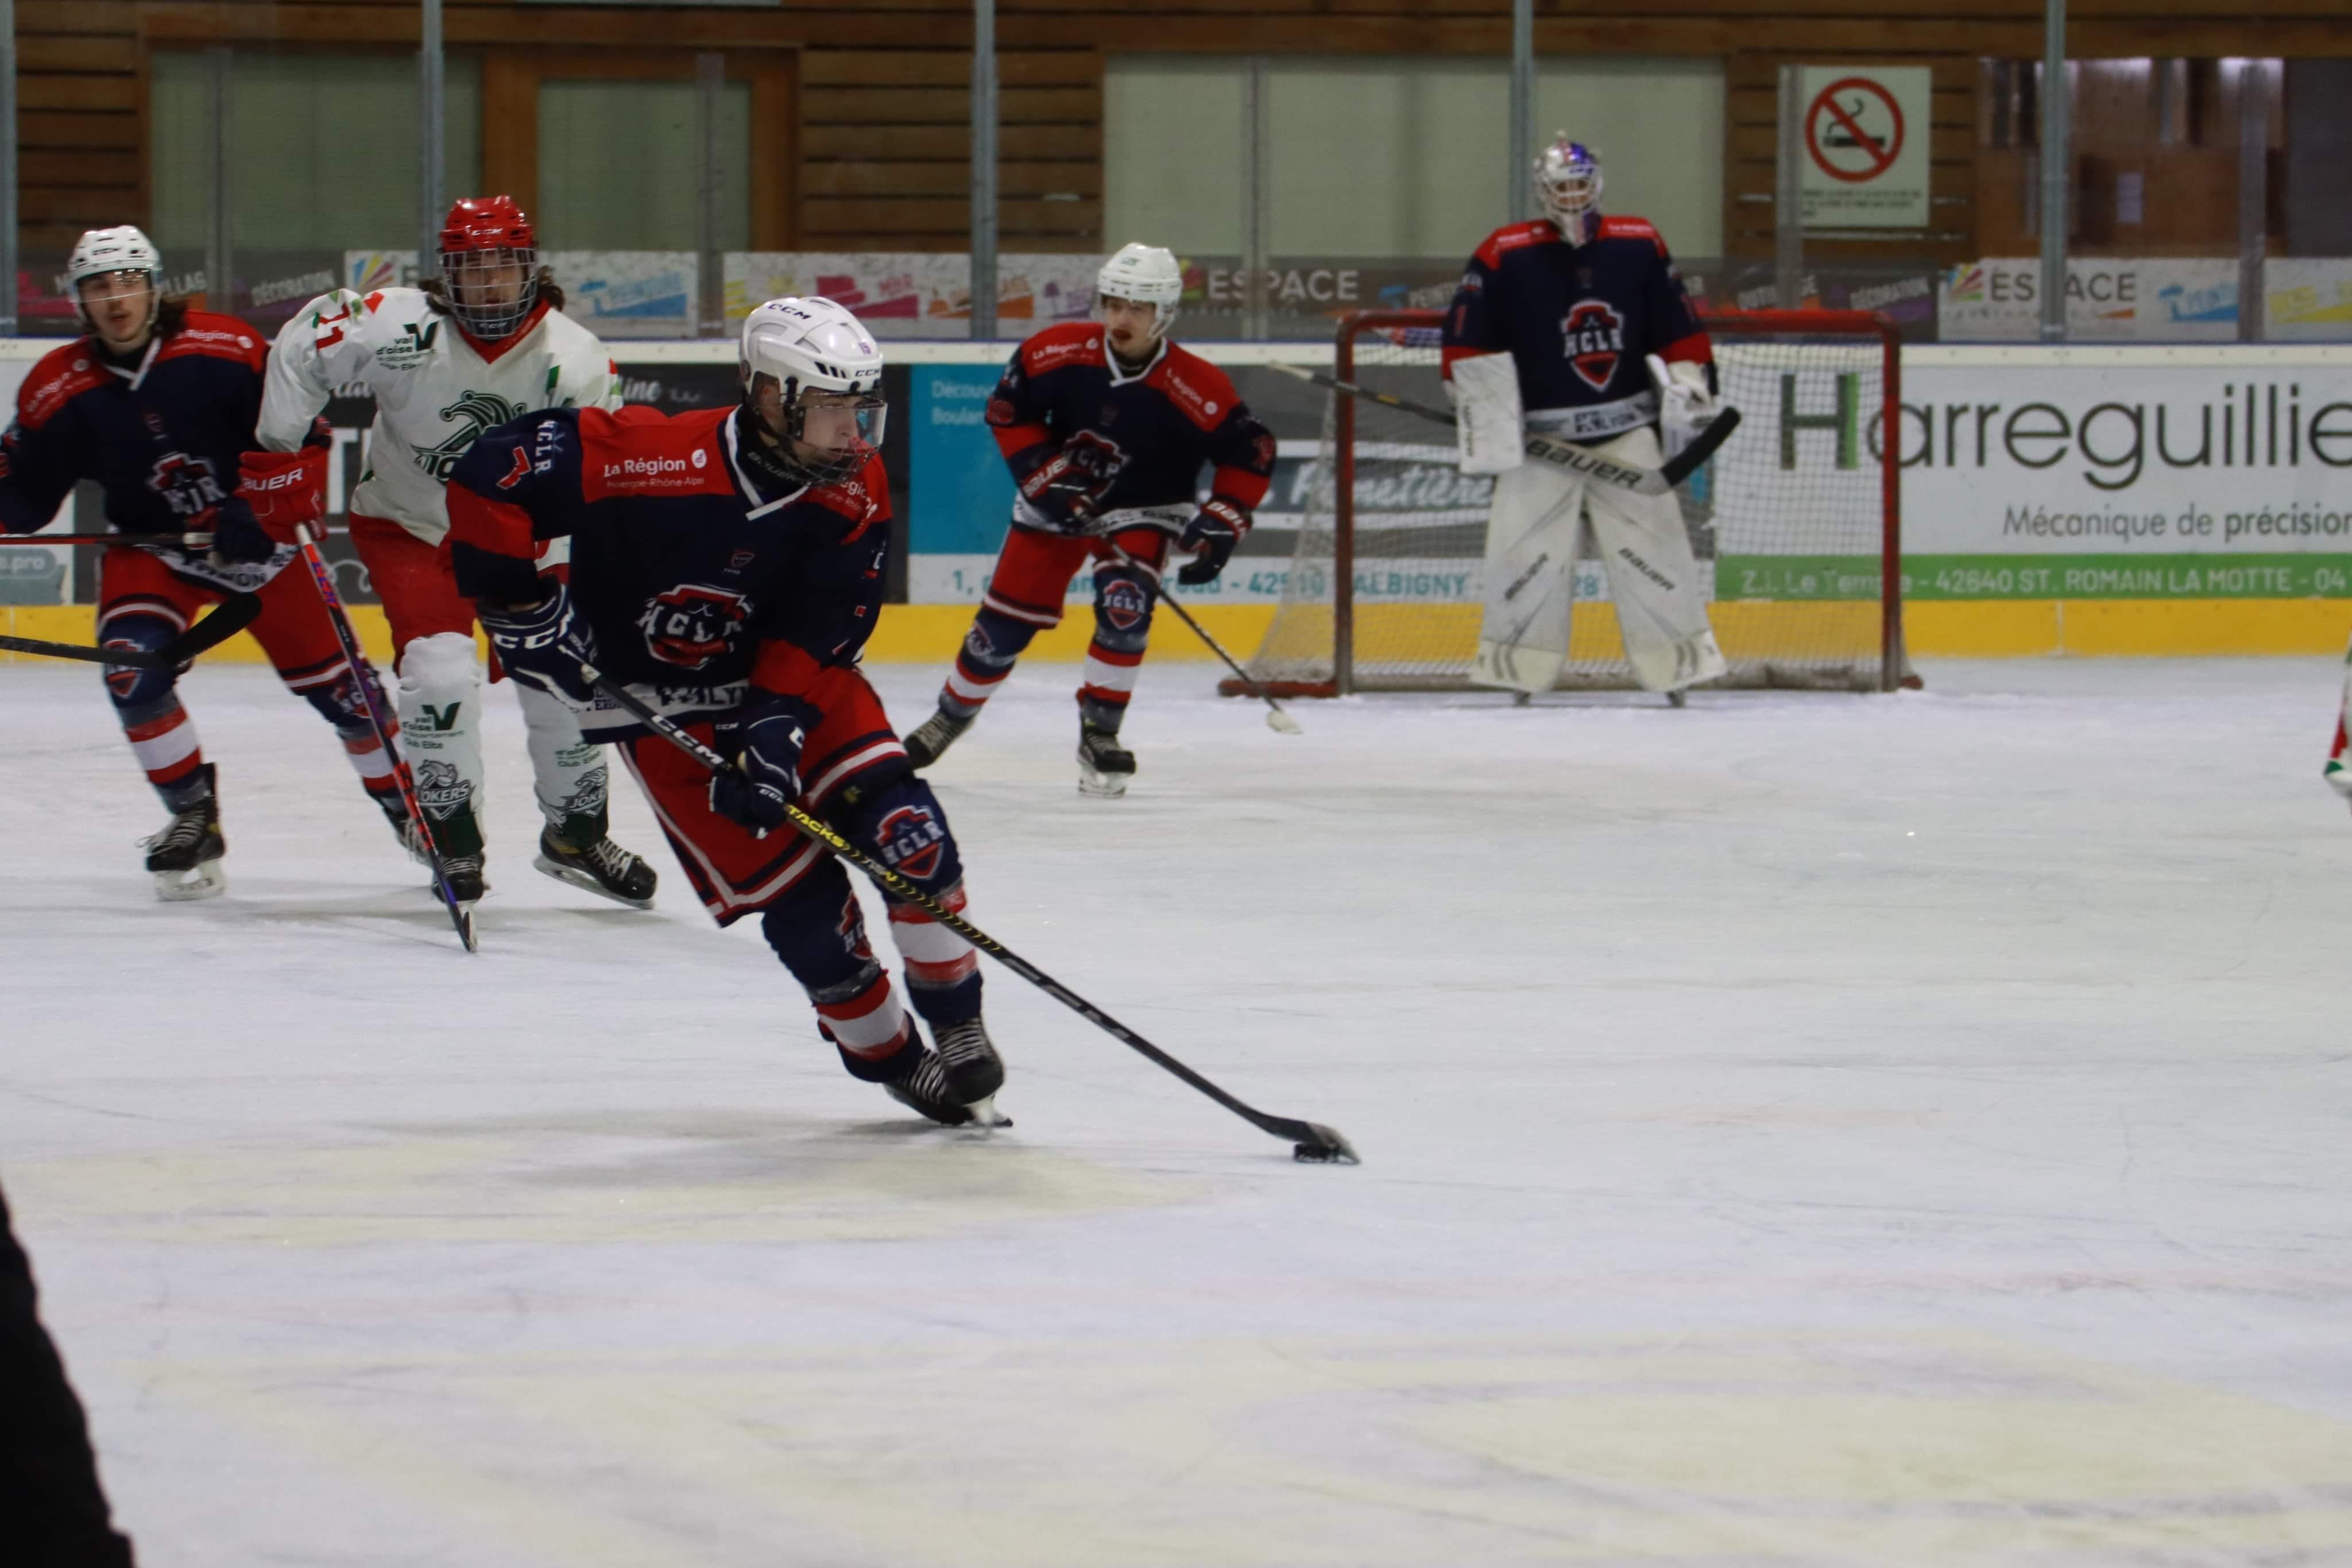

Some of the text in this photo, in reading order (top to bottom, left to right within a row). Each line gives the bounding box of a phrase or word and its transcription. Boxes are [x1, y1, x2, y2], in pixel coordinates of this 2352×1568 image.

[1208, 269, 1359, 300] ESPACE
[1991, 273, 2136, 301] ESACE
[767, 303, 811, 319] CCM
[1563, 327, 1624, 358] HCLR
[604, 456, 686, 478] La Région
[2002, 503, 2167, 543] Mécanique
[2177, 503, 2213, 536] de
[2065, 568, 2163, 594] ROMAIN
[2168, 568, 2200, 594] LA
[2208, 568, 2292, 594] MOTTE
[650, 714, 725, 765] CCM
[415, 783, 470, 803] OKERS
[787, 804, 846, 849] TACKS
[881, 820, 946, 865] HCLR
